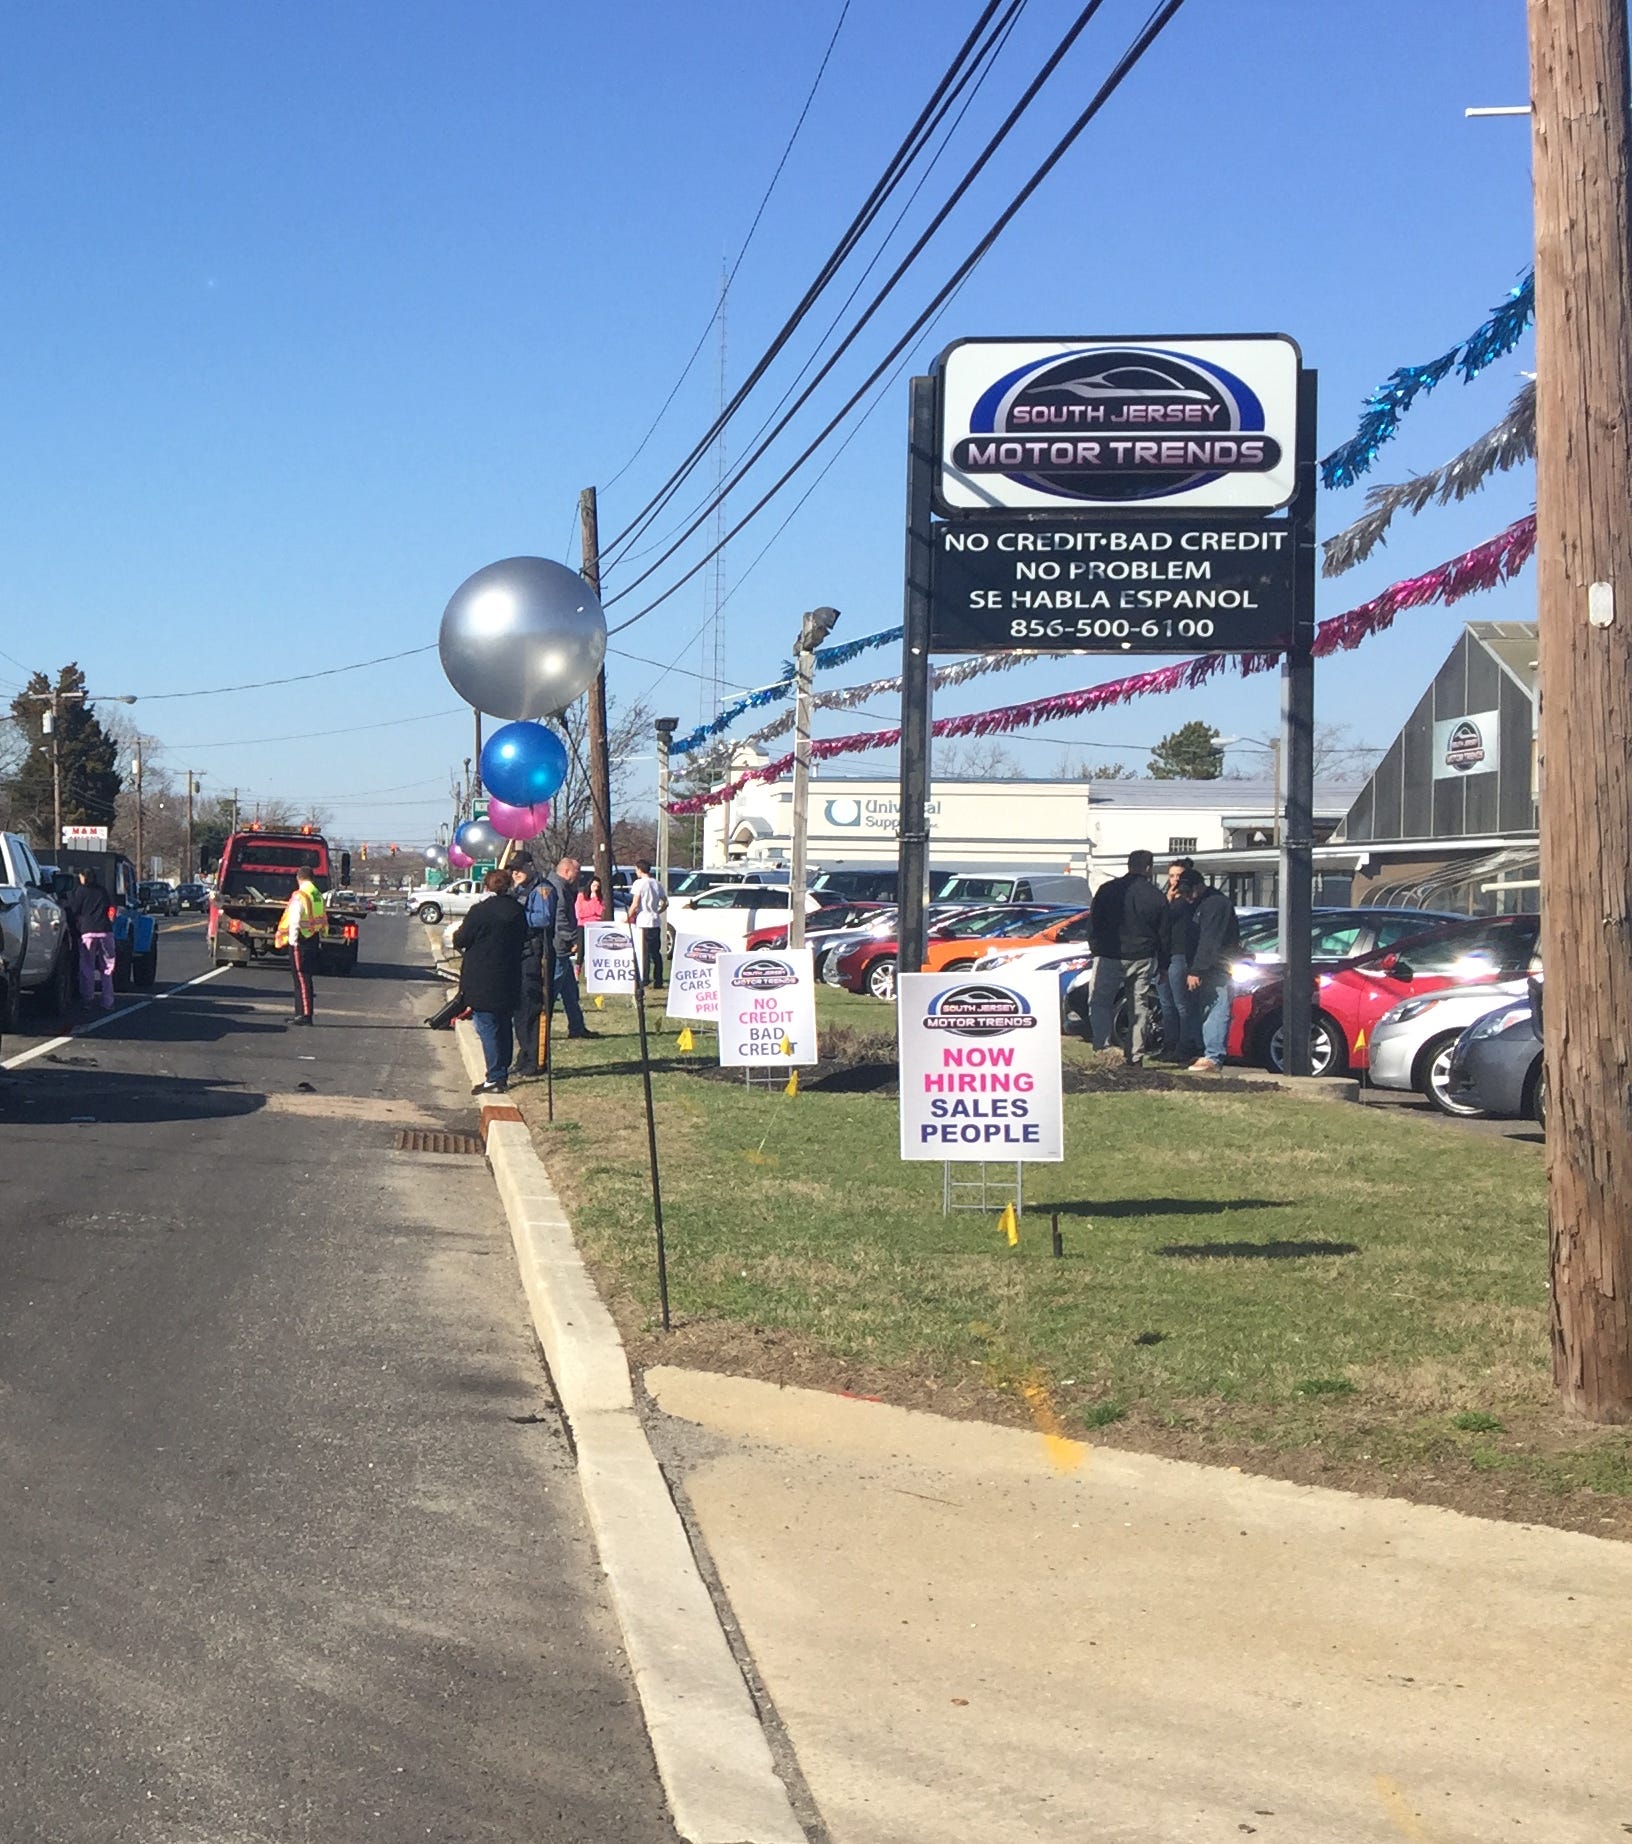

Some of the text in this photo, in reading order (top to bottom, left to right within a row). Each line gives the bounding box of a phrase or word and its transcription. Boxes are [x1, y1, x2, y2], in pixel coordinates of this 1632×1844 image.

[1013, 404, 1221, 424] SOUTH JERSEY
[968, 441, 1265, 466] MOTOR TRENDS
[944, 533, 989, 551] NO
[1180, 531, 1289, 550] CREDIT
[1015, 561, 1212, 580] NO PROBLEM
[969, 589, 1259, 609] SE HABLA ESPANOL
[1010, 619, 1215, 638] 856-500-6100
[865, 800, 941, 815] Unival
[592, 959, 635, 968] WE BU
[675, 968, 713, 981] GREAT
[680, 980, 711, 991] CARS
[695, 991, 718, 1002] GRE
[754, 998, 777, 1010] NO
[942, 1004, 1016, 1012] SOUTH JERSEY
[738, 1011, 794, 1024] CREDIT
[927, 1017, 1033, 1027] MOTOR TRENDS
[750, 1028, 785, 1040] BAD
[738, 1042, 798, 1056] CREDT
[943, 1048, 1015, 1067] NOW
[924, 1073, 1035, 1093] HIRING
[930, 1098, 1029, 1118] SALES
[921, 1124, 1040, 1143] PEOPLE
